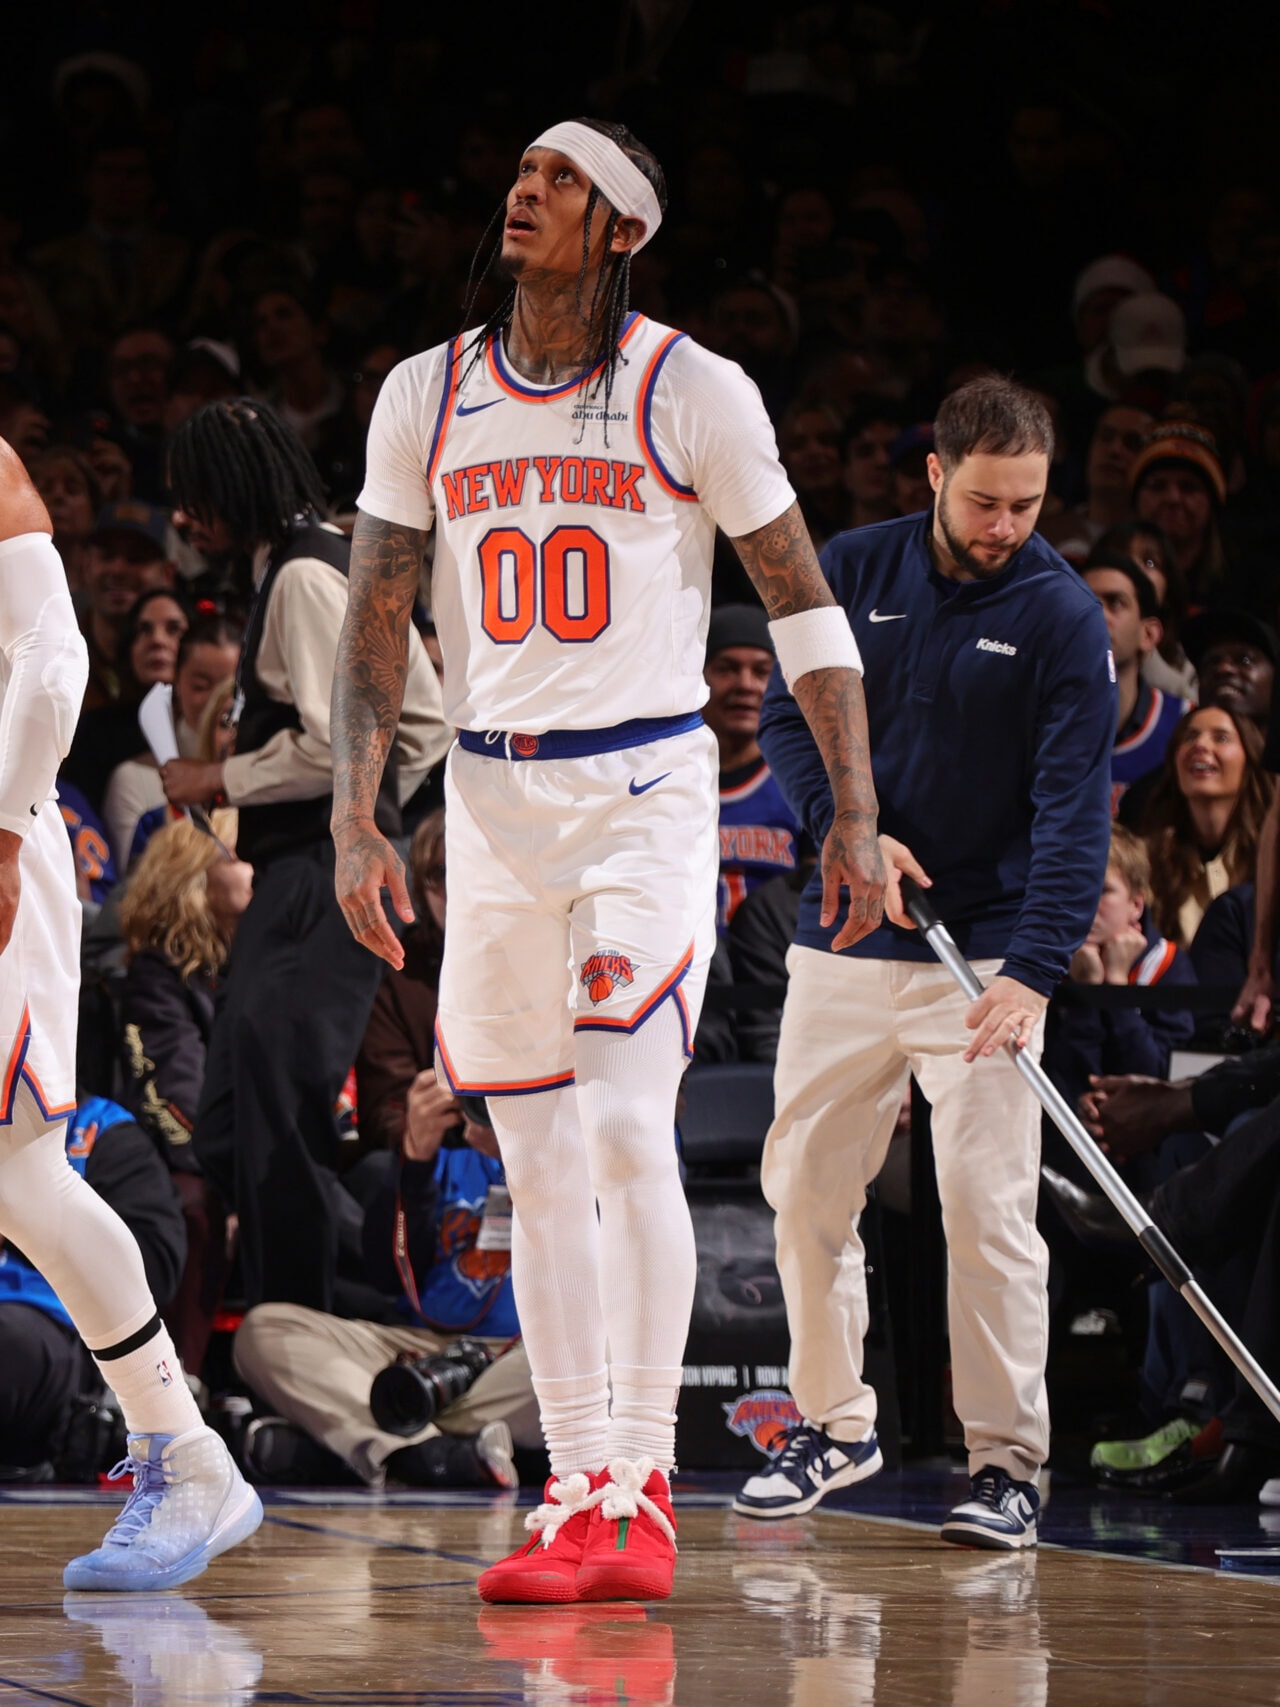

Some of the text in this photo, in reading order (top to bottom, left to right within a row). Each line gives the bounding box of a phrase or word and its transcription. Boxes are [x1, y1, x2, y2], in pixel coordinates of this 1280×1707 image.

[571, 410, 629, 421] abu dhabi
[441, 456, 646, 521] NEW YORK
[477, 525, 611, 645] 00
[976, 638, 1017, 656] Knicks
[718, 825, 796, 868] YORK
[580, 955, 634, 983] KNICKS
